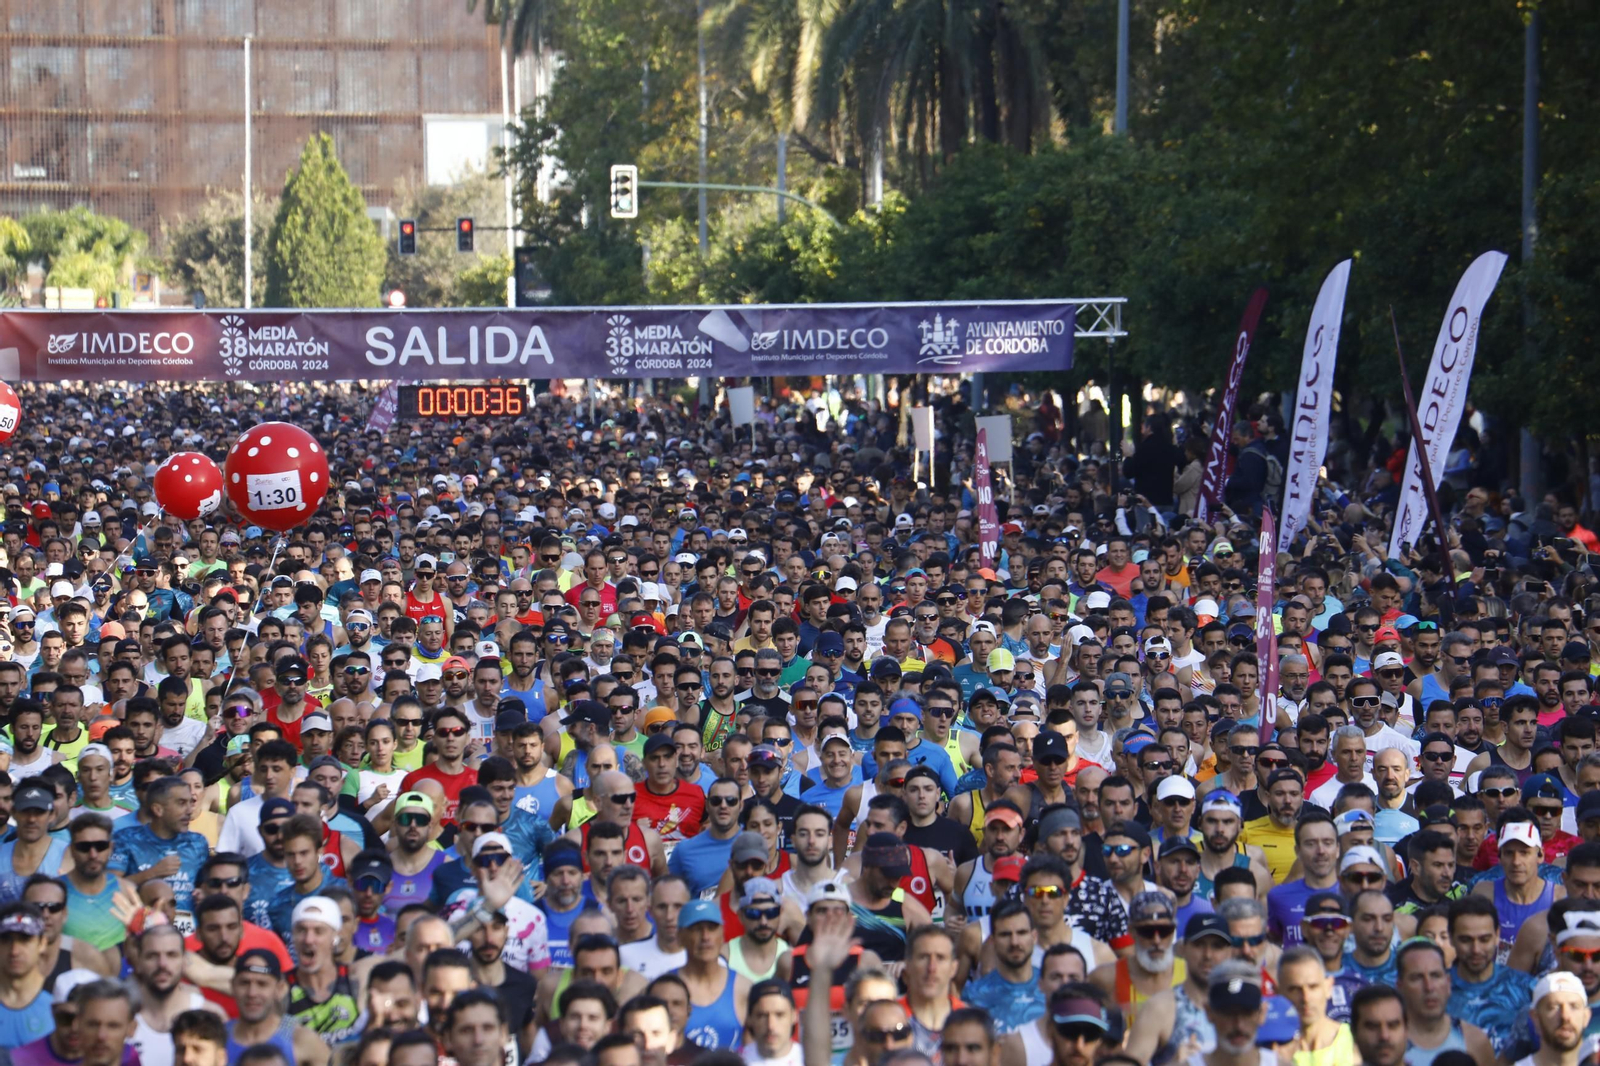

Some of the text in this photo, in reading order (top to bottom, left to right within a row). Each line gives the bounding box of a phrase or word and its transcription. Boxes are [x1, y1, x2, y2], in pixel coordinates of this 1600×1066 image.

[248, 326, 298, 340] MEDIA
[634, 325, 683, 339] MEDIA
[966, 319, 1065, 338] AYUNTAMIENTO
[82, 332, 194, 354] IMDECO
[219, 337, 248, 358] 38
[249, 336, 329, 356] MARATÓN
[365, 325, 554, 366] SALIDA
[605, 336, 634, 357] 38
[635, 335, 712, 355] MARATÓN
[783, 328, 889, 350] IMDECO
[966, 335, 1049, 355] DE CÓRDOBA
[48, 356, 193, 366] Instituto Municipal de Deportes Córdoba
[248, 357, 329, 370] CÓRDOBA 2024
[635, 357, 713, 369] CÓRDOBA 2024
[781, 354, 815, 362] Municipal
[826, 352, 857, 361] Deportes
[858, 351, 888, 360] Córdoba
[418, 388, 521, 415] 00:00:36
[1440, 369, 1464, 424] Deportes
[1203, 331, 1247, 493] IMDECO
[254, 487, 296, 506] 1:30
